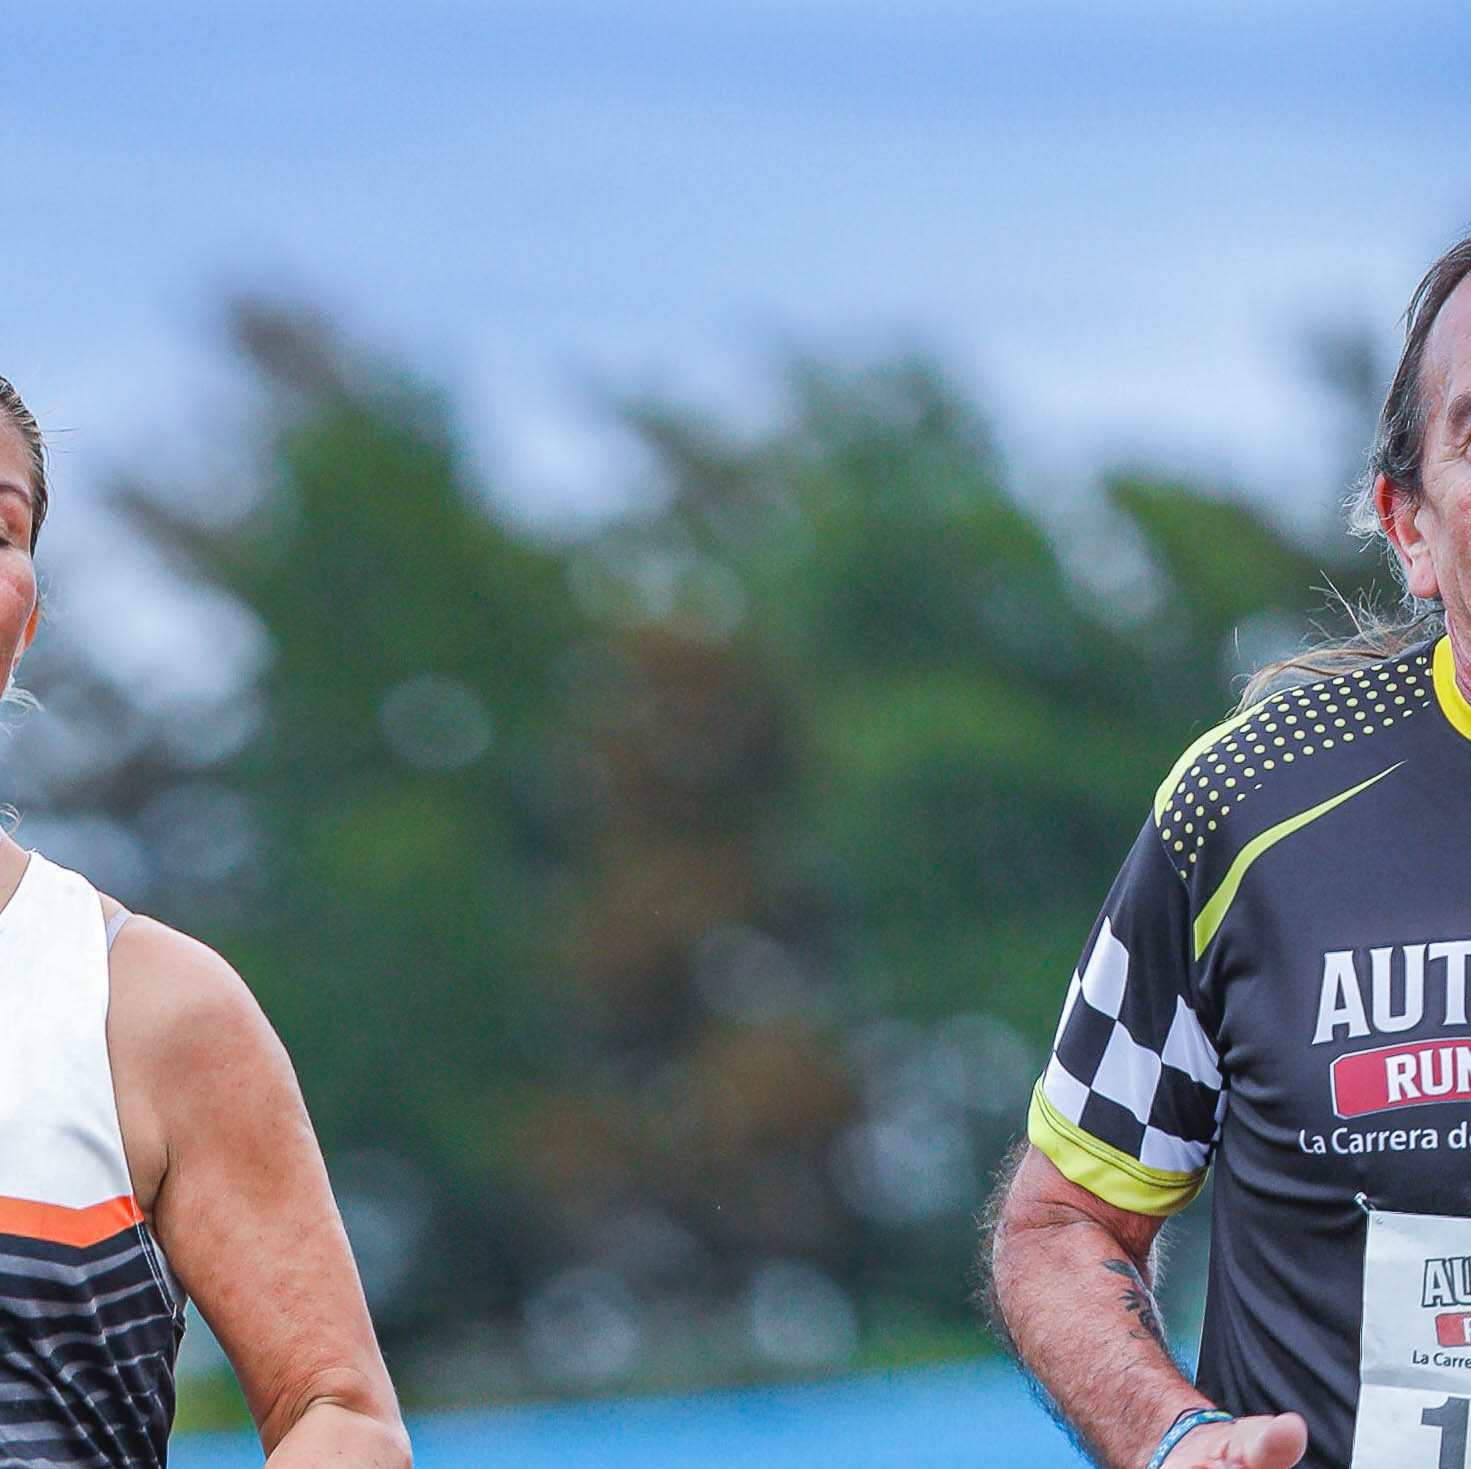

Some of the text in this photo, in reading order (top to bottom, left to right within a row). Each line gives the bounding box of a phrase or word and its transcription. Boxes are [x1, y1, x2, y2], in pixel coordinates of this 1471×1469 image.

[1298, 1120, 1471, 1155] La Carrera d
[1412, 1350, 1429, 1365] La
